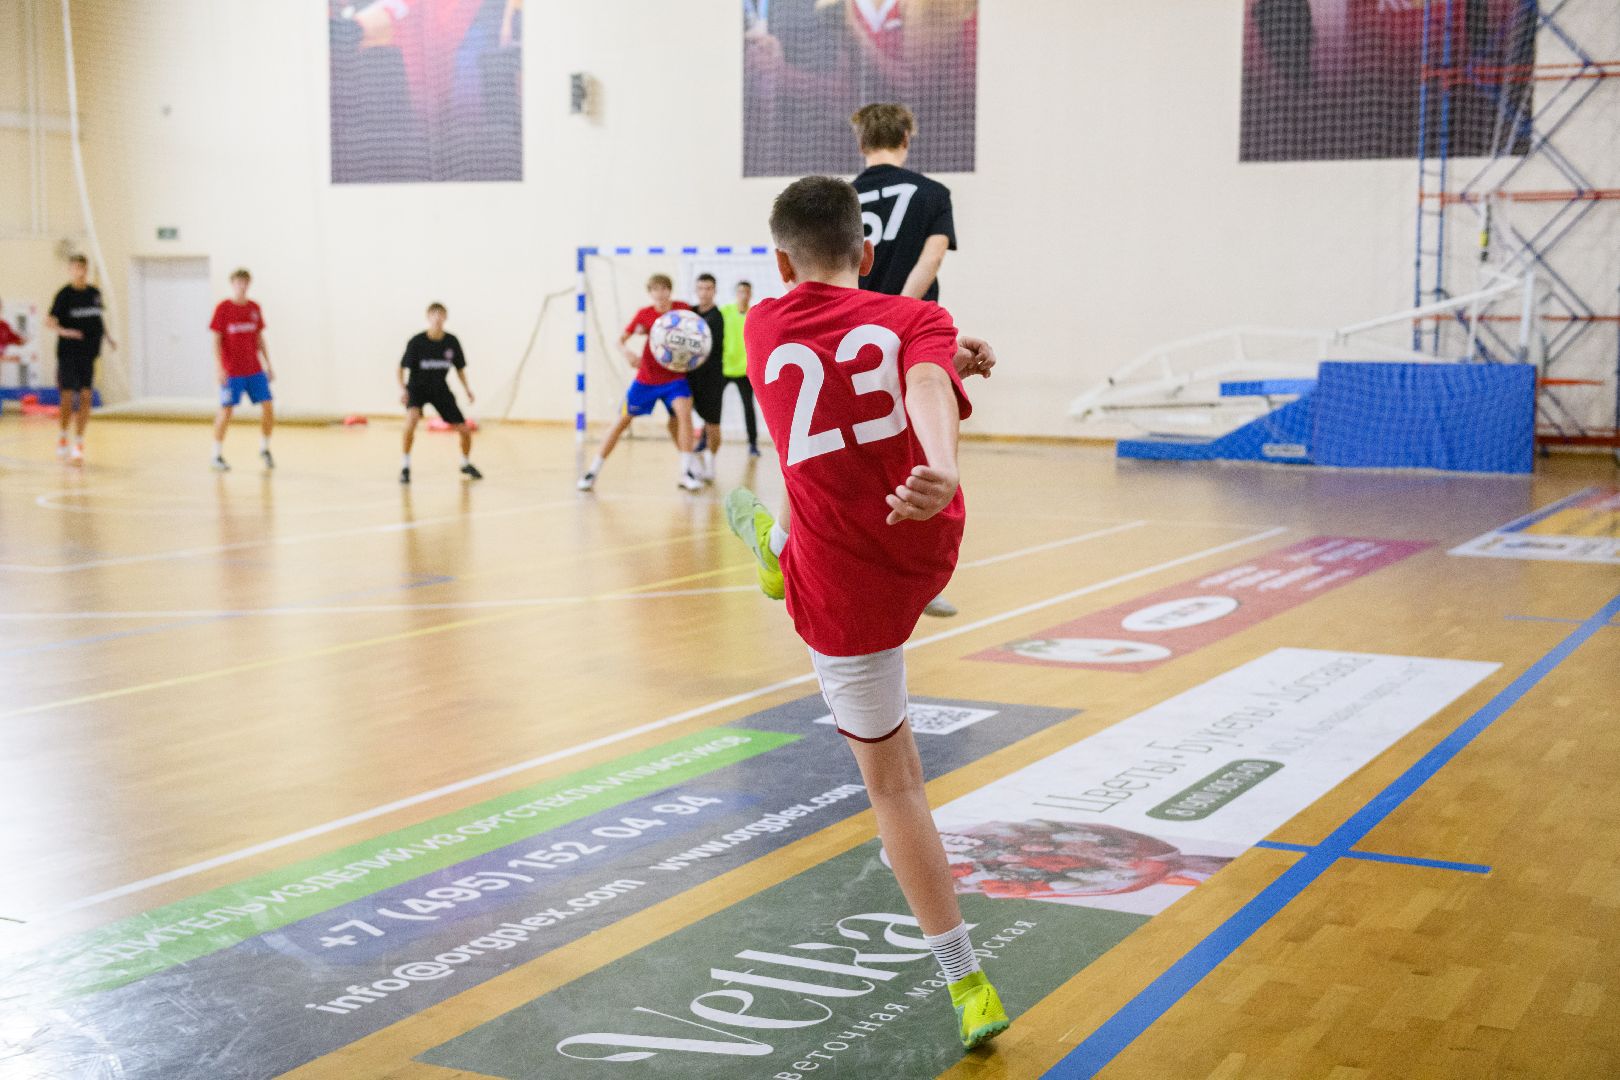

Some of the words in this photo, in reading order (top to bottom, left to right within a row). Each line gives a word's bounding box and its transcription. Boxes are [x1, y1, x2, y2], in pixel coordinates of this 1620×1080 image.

[858, 183, 918, 247] 57
[765, 324, 908, 467] 23
[1032, 756, 1187, 813] Цветы
[255, 847, 414, 904] ИЗДЕЛИЙ
[408, 833, 468, 856] ИЗ
[305, 878, 646, 1014] info@orgplex.com
[648, 783, 866, 871] www.orgplex.com
[319, 919, 385, 948] +7
[377, 871, 535, 921] (495)
[507, 841, 608, 869] 152
[591, 816, 668, 839] 04
[652, 795, 723, 815] 94
[904, 920, 1038, 998] марская
